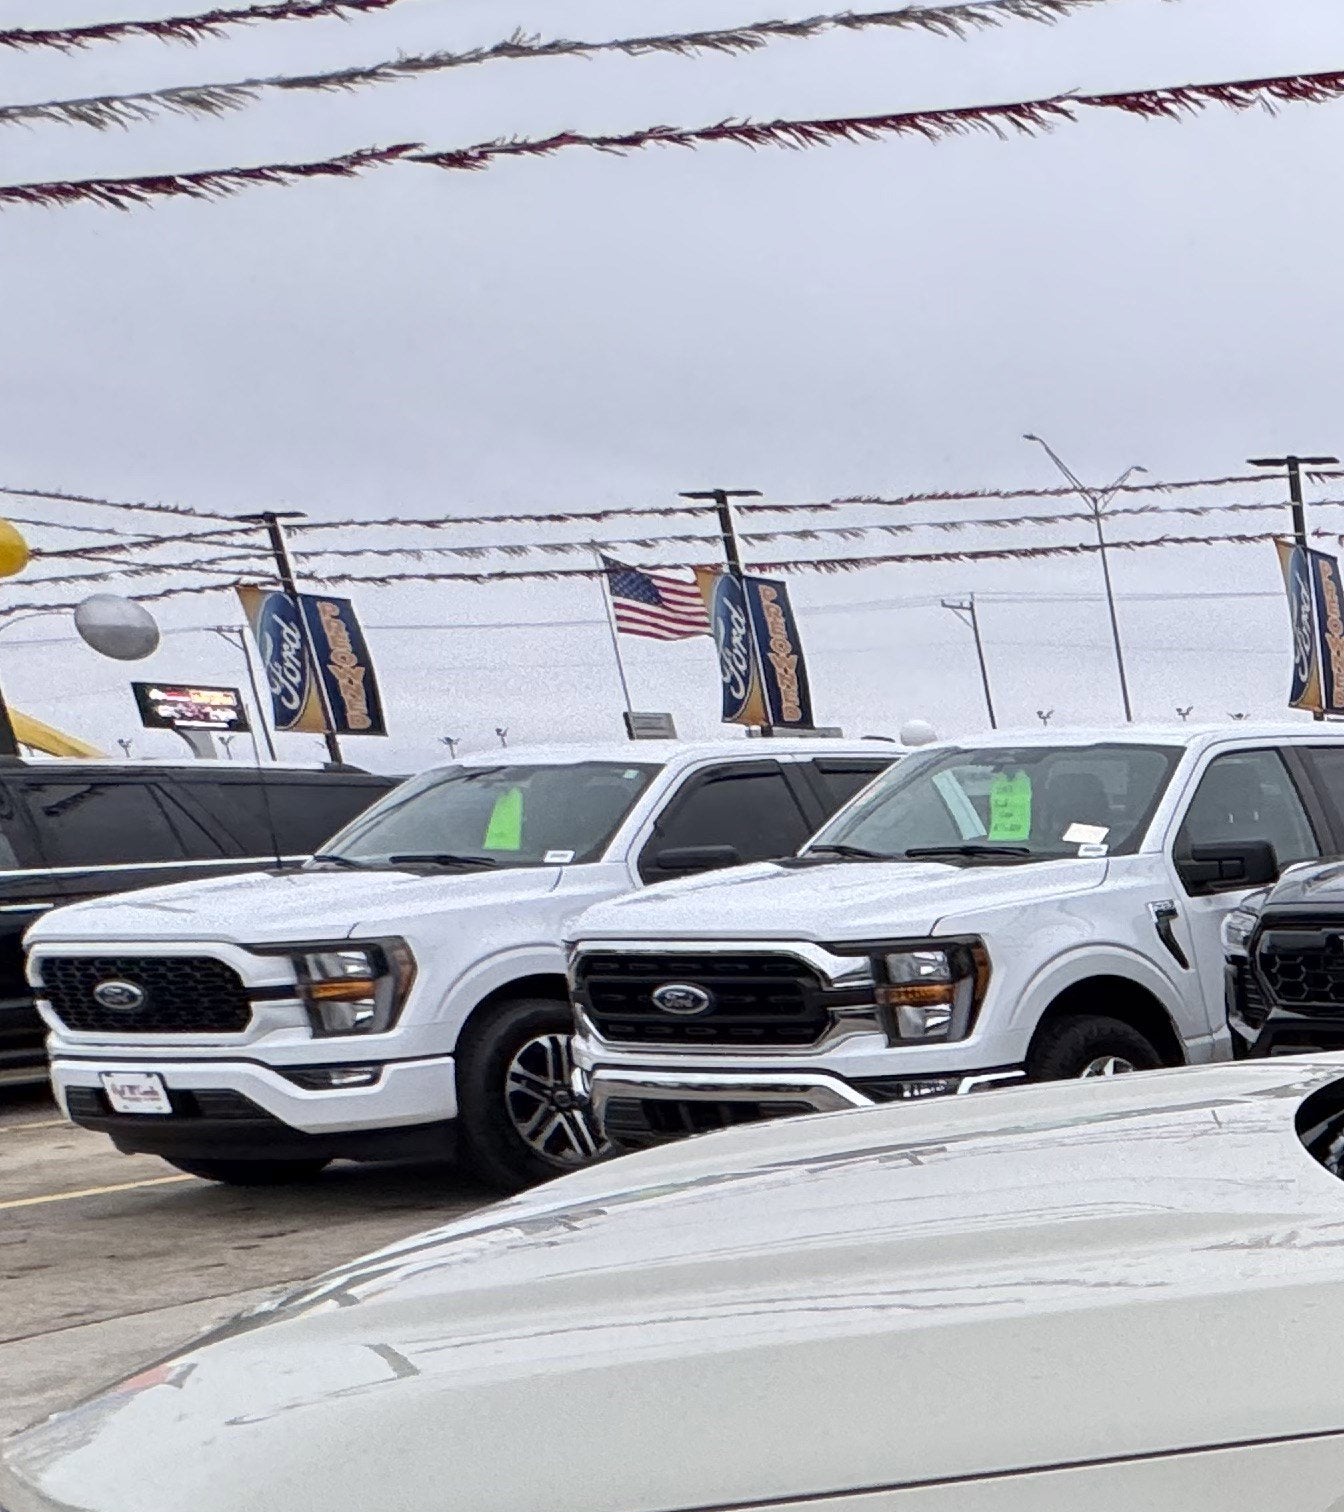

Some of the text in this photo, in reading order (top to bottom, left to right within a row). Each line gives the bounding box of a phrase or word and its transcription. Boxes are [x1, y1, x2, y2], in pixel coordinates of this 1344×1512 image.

[262, 613, 301, 710] Ford
[715, 596, 748, 700] Ford
[1291, 572, 1311, 683] Ford
